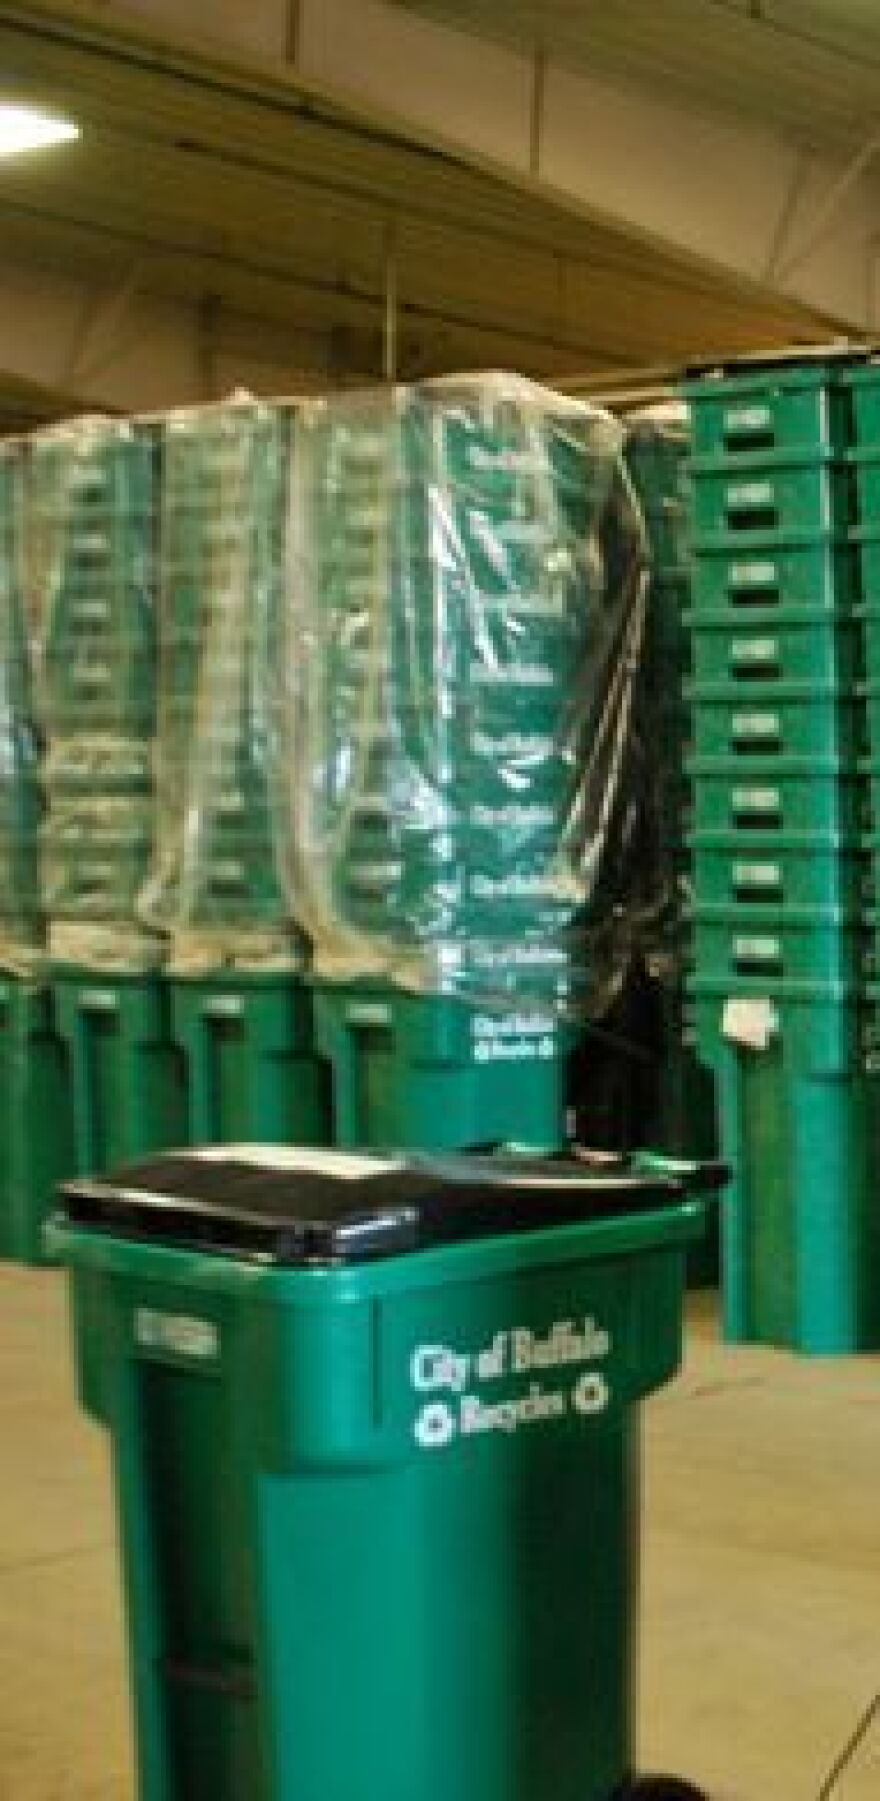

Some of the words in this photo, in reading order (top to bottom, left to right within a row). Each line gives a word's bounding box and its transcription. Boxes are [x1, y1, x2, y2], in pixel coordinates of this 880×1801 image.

[411, 1343, 470, 1392] City
[475, 1330, 508, 1379] of
[512, 1315, 612, 1373] Buffalo
